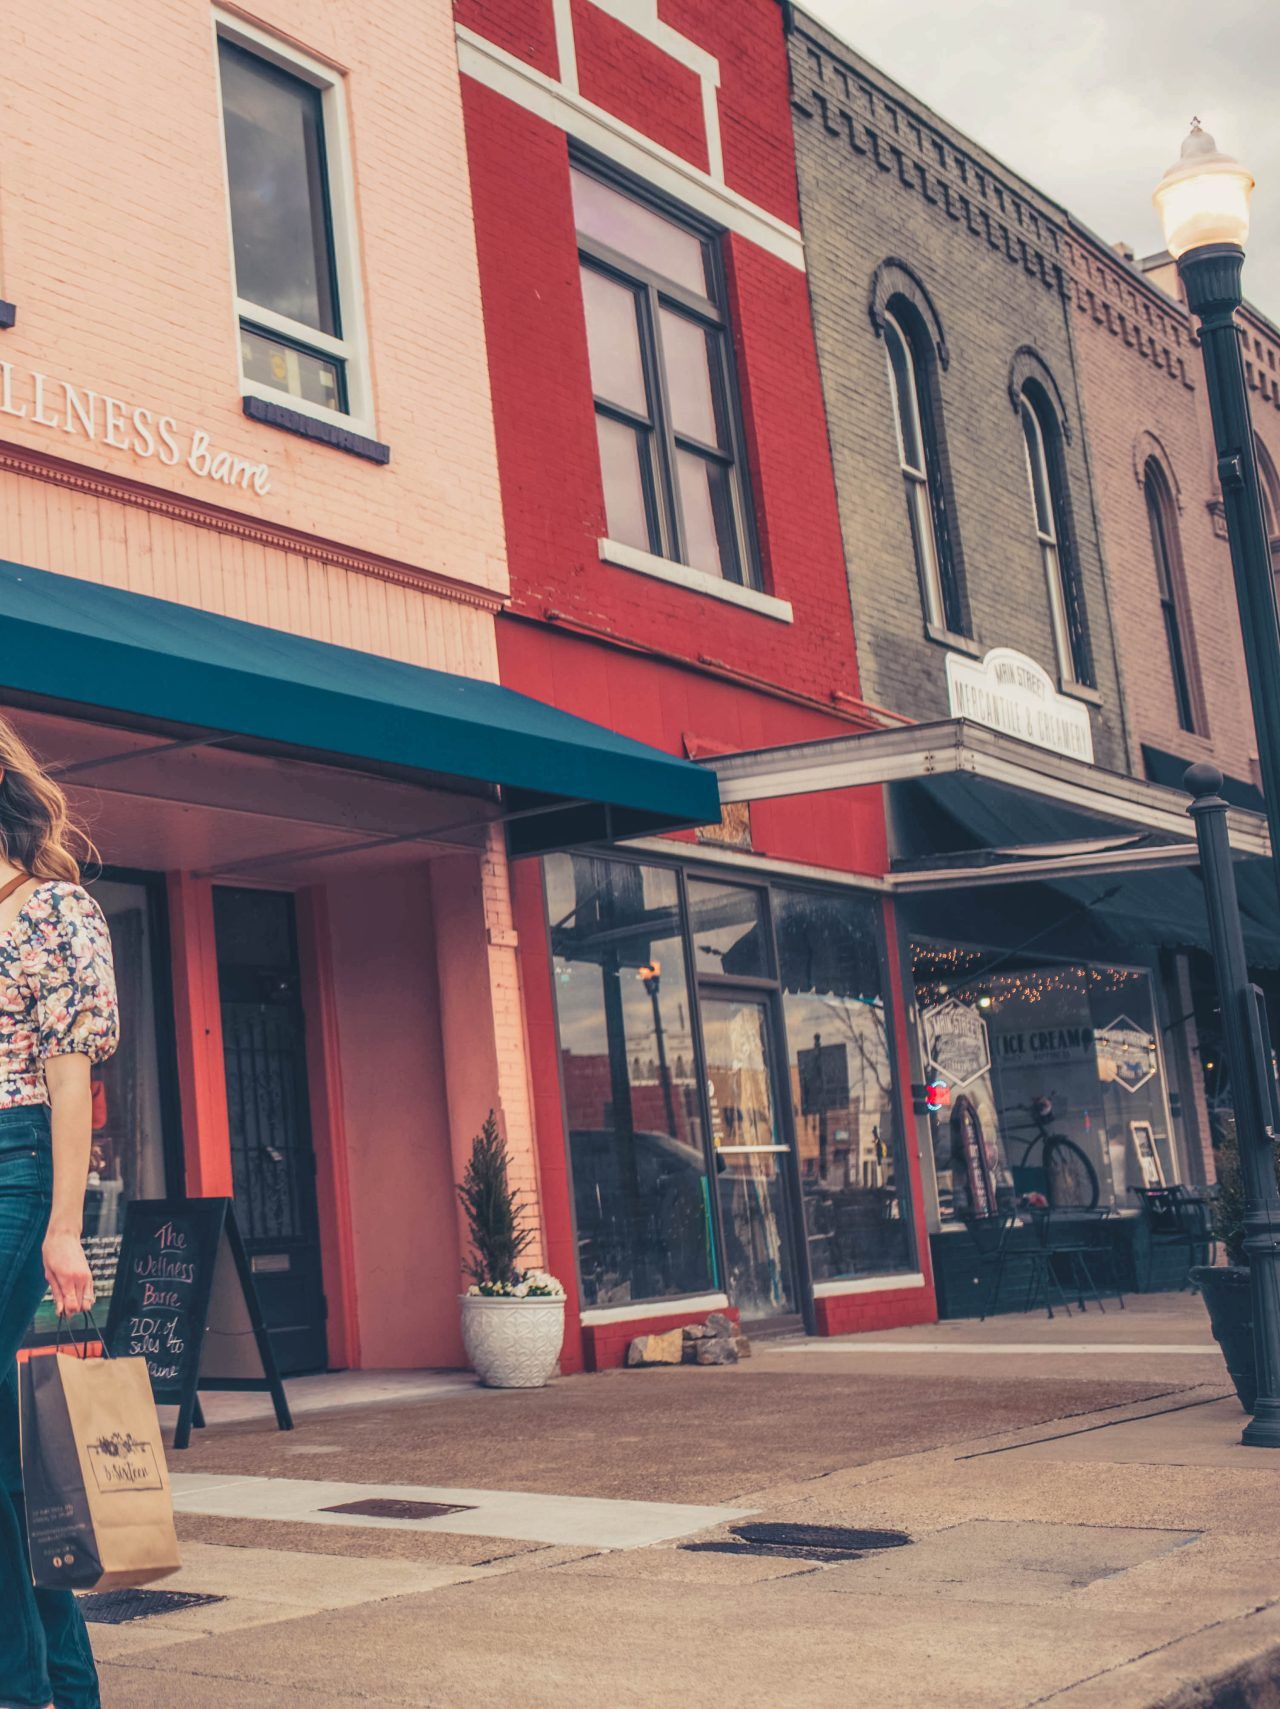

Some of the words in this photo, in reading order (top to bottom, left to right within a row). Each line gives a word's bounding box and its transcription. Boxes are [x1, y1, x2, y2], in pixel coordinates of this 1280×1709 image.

[187, 430, 272, 497] Barre
[995, 663, 1015, 685] MAIN
[1017, 665, 1046, 698] STREET
[954, 680, 1021, 733] MERCANTILE
[1003, 1033, 1026, 1055] ICE
[1030, 1028, 1080, 1052] CREAM
[154, 1222, 187, 1249] The
[134, 1255, 195, 1283] Wellness
[142, 1283, 181, 1307] Barre
